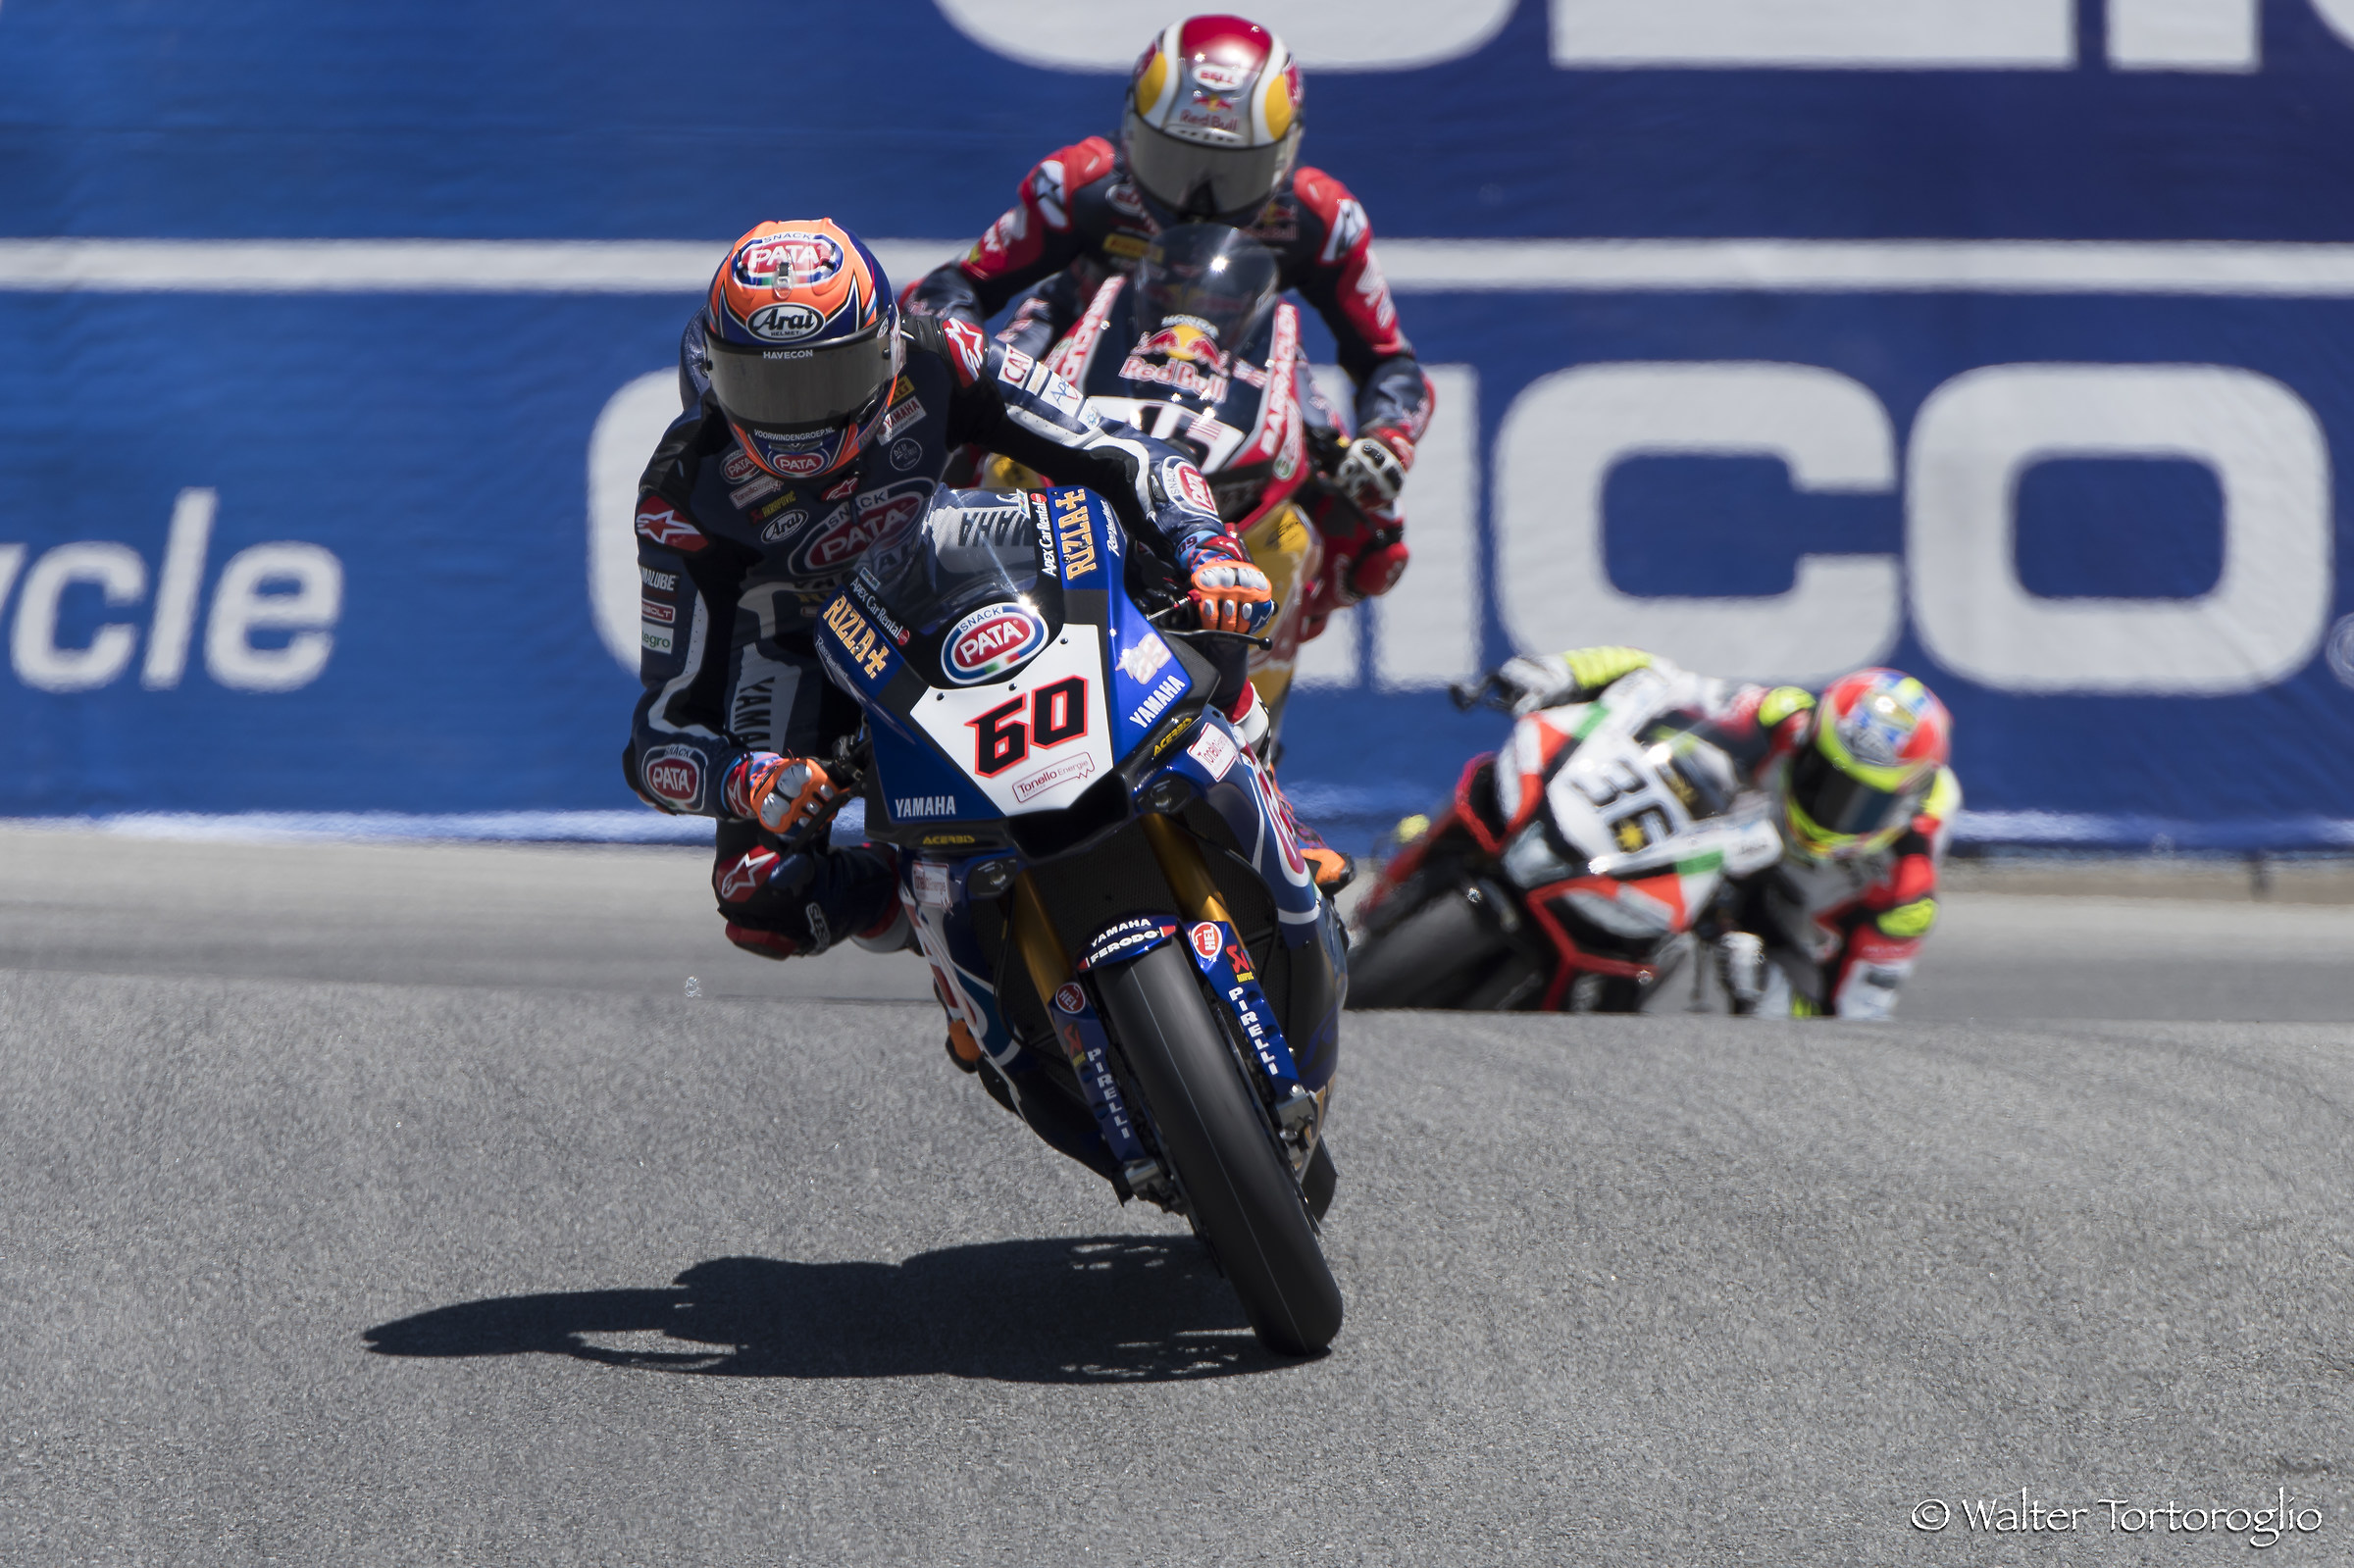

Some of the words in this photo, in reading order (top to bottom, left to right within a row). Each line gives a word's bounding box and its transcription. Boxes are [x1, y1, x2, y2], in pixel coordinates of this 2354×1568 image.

[761, 231, 813, 243] SNACK
[749, 244, 820, 271] PATA
[752, 308, 814, 330] Arai
[763, 349, 813, 360] HAVECON
[885, 398, 920, 430] YAMAHA
[781, 453, 816, 470] PATA
[768, 512, 802, 540] Arai
[820, 509, 909, 562] PATA
[0, 486, 345, 693] cle
[959, 606, 1001, 632] SNACK
[959, 622, 1024, 664] PATA
[1128, 675, 1186, 730] YAMAHA
[964, 675, 1090, 779] 60
[1152, 717, 1193, 757] ACERBIS
[652, 767, 691, 792] PATA
[1017, 770, 1057, 794] Tonello
[895, 795, 956, 818] YAMAHA
[922, 835, 976, 845] ACERBIS
[1091, 918, 1152, 948] YAMAHA
[1204, 926, 1216, 951] HEL
[1090, 931, 1159, 964] FERODO
[1058, 989, 1076, 1011] HEL
[1228, 986, 1279, 1077] PIRELLI
[1087, 1047, 1131, 1139] PIRELLI
